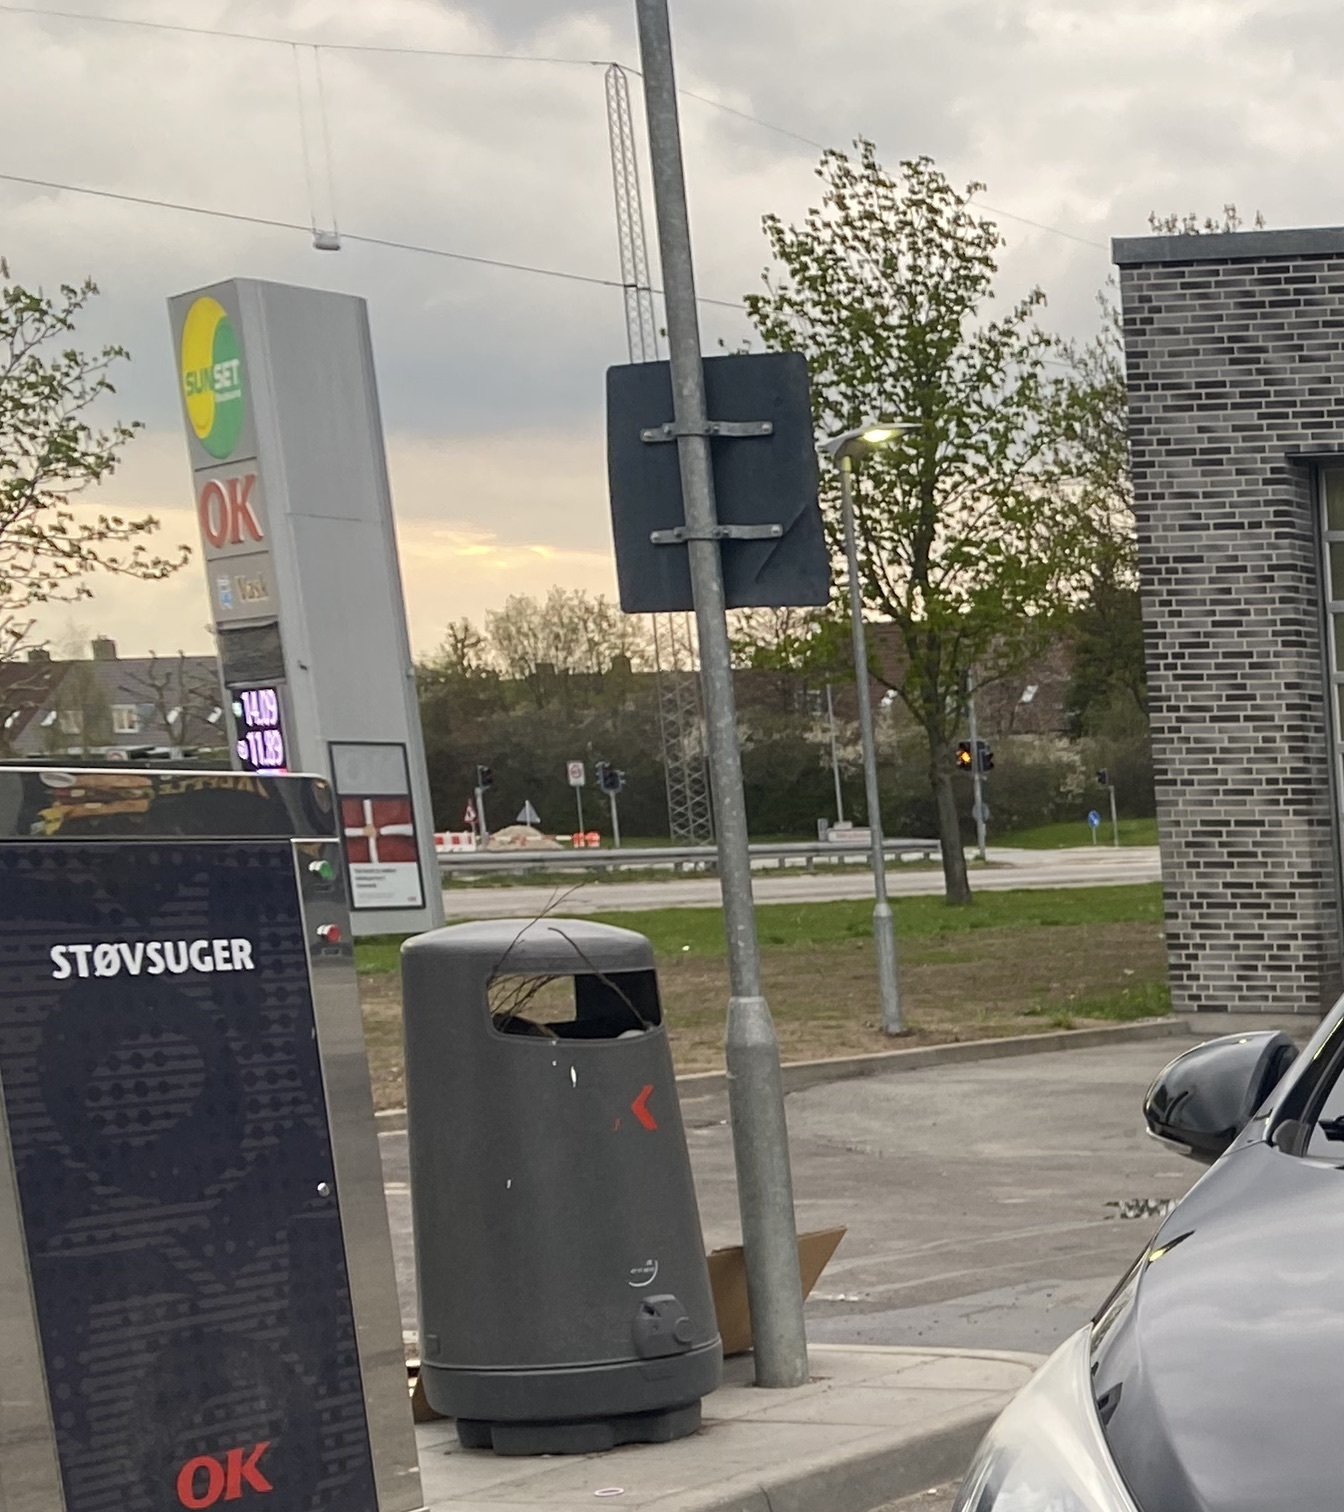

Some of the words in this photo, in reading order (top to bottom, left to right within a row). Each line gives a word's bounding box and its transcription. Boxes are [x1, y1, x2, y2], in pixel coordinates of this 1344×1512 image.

[185, 358, 240, 396] SUNSET
[200, 473, 264, 549] OK
[50, 937, 255, 980] STØVSUGER
[176, 1440, 273, 1510] OK
